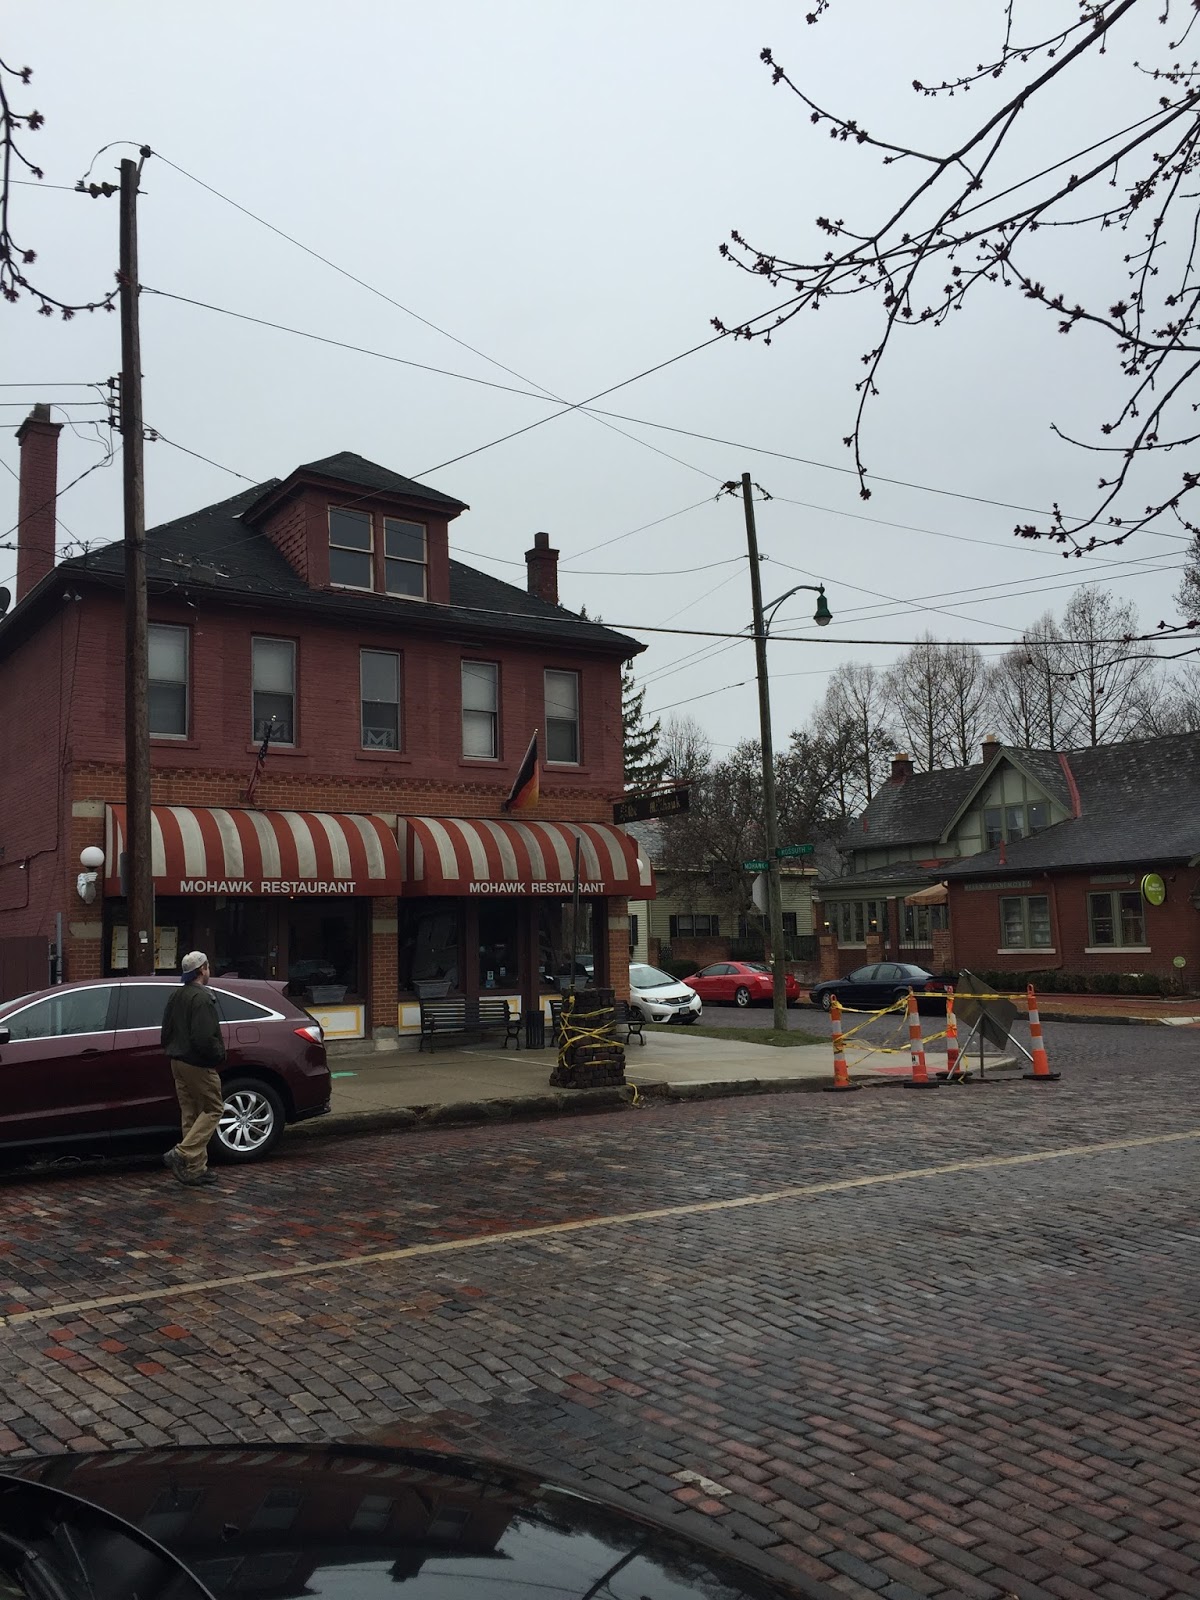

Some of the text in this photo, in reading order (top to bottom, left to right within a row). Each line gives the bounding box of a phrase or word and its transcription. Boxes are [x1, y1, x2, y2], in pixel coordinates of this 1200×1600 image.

[180, 880, 356, 893] MOHAWK RESTAURANT
[469, 882, 605, 893] MOHAWK RESTAURANT
